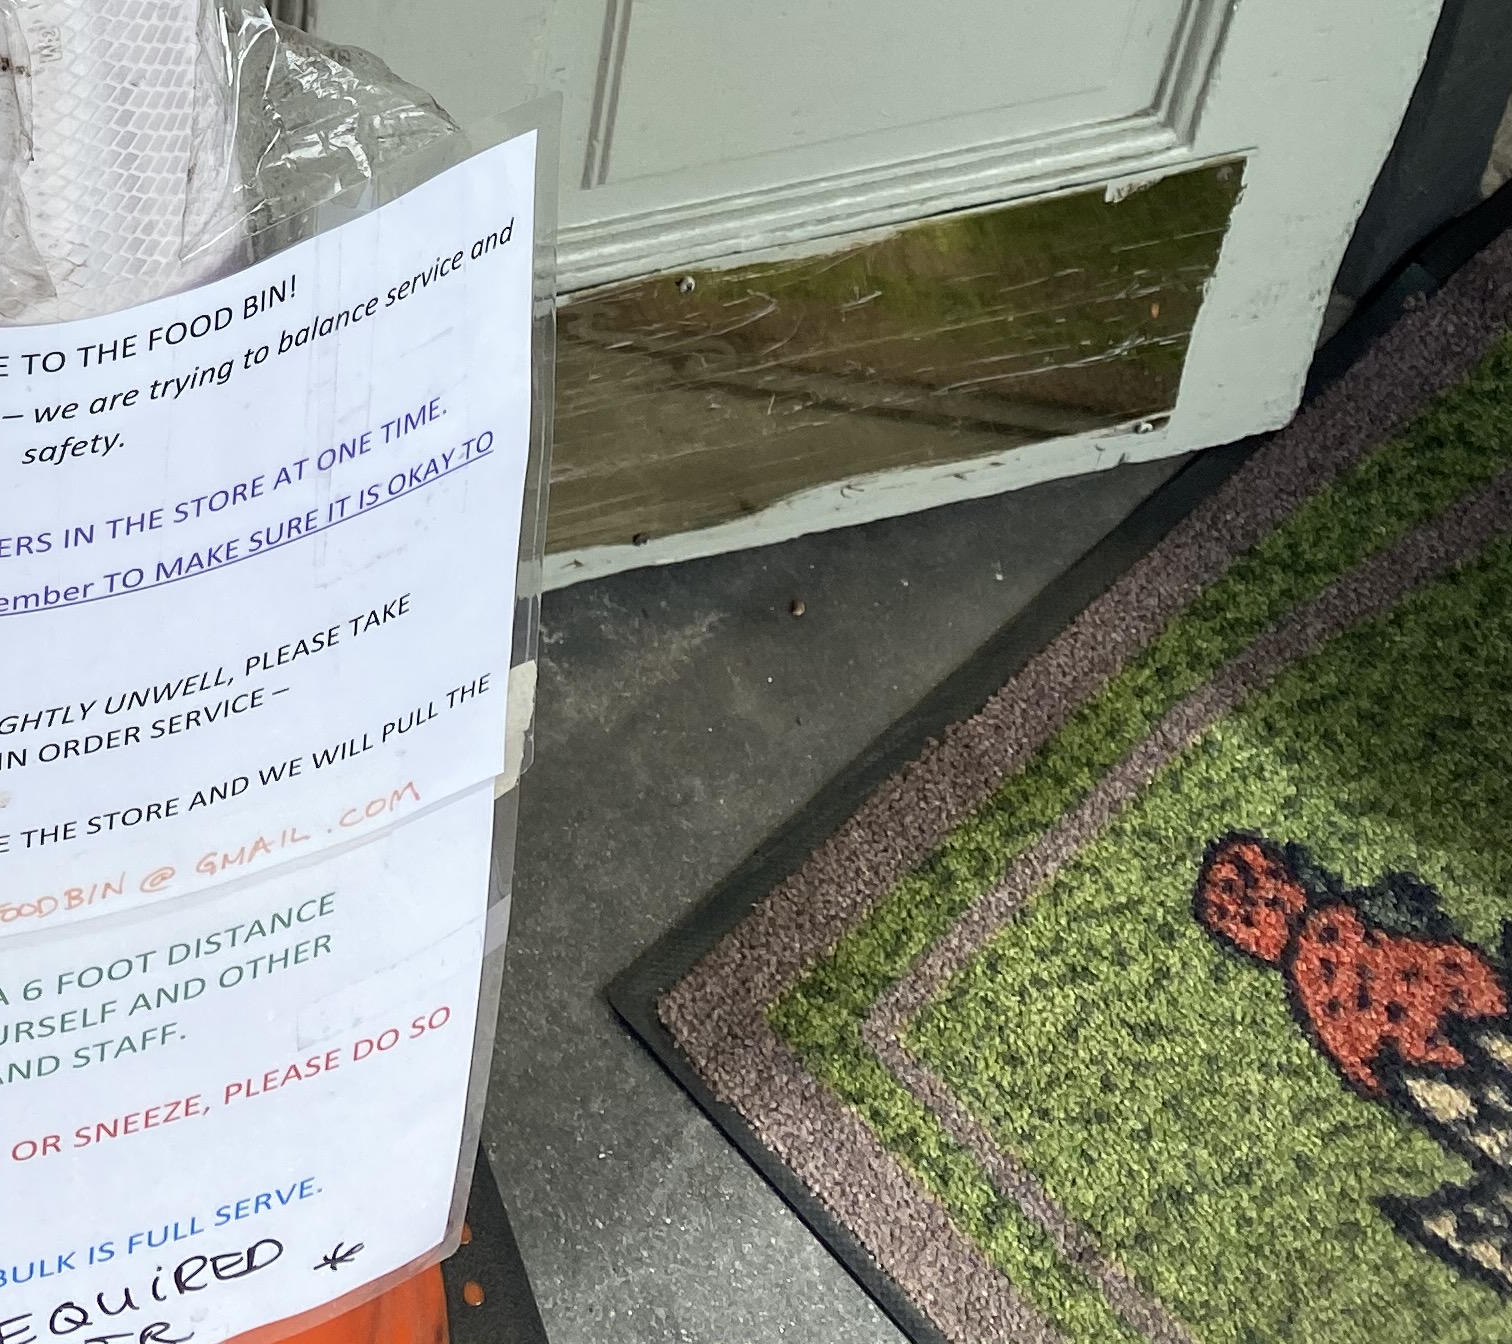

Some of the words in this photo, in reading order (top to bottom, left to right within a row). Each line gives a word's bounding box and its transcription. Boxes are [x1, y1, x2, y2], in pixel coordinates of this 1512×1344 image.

[21, 352, 65, 375] TO
[77, 335, 137, 367] THE
[149, 307, 232, 351] FOOD
[244, 274, 295, 320] BIN!
[35, 403, 79, 423] we
[90, 389, 139, 414] are
[150, 359, 234, 400] trying
[244, 346, 269, 369] to
[278, 297, 378, 355] balance
[385, 251, 463, 307] service
[471, 217, 514, 259] and
[22, 433, 124, 465] safety.
[65, 525, 94, 548] IN
[106, 508, 164, 539] THE
[174, 475, 264, 523] STORE
[273, 458, 309, 490] AT
[317, 431, 372, 471] ONE
[381, 397, 446, 443] TIME.
[103, 568, 144, 593] TO
[156, 539, 239, 581] MAKE
[249, 509, 318, 552] SURE
[328, 496, 351, 523] IT
[360, 484, 381, 509] IS
[388, 448, 455, 495] OKAY
[460, 431, 493, 460] TO
[105, 667, 233, 714] UNWELL,
[246, 625, 340, 676] PLEASE
[348, 593, 410, 636] TAKE
[20, 821, 77, 848] THE
[87, 797, 179, 834] STORE
[188, 777, 249, 811] AND
[259, 757, 302, 785] WE
[312, 733, 373, 768] WILL
[382, 701, 438, 743] PULL
[446, 673, 490, 708] THE
[39, 726, 140, 762] ORDER
[150, 688, 264, 739] SERVICE
[23, 979, 42, 1001] 6
[58, 951, 156, 994] FOOT
[169, 892, 335, 965] DISTANCE
[128, 978, 205, 1016] AND
[220, 935, 330, 988] OTHER
[12, 1135, 61, 1160] OR
[74, 1095, 209, 1147] SNEEZE,
[225, 1049, 341, 1104] PLEASE
[354, 1029, 399, 1061] DO
[410, 1007, 450, 1038] SO
[73, 1023, 185, 1068] STAFF.
[89, 1242, 115, 1265] IS
[128, 1217, 204, 1254] FULL
[215, 1177, 322, 1226] SERVE.
